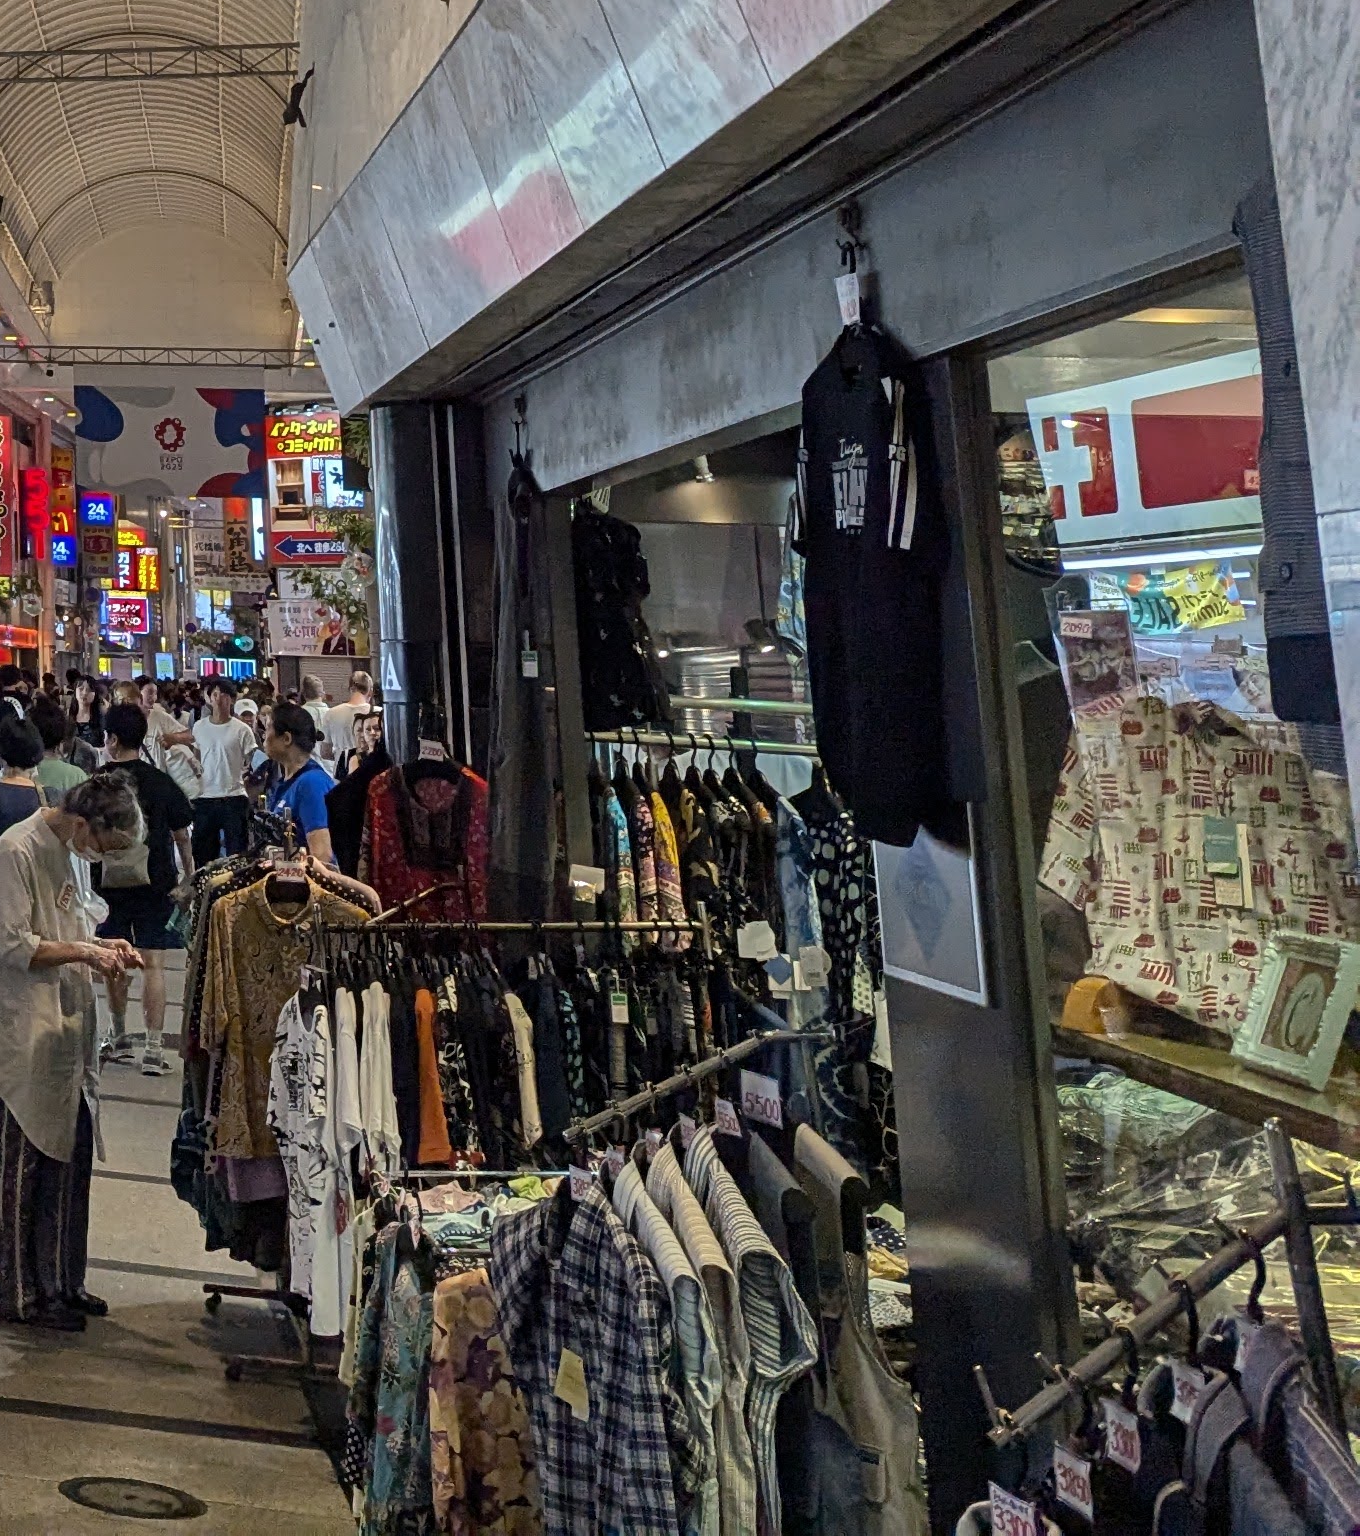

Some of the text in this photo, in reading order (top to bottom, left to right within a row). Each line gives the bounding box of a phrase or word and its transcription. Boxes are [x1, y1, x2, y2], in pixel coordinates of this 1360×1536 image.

[270, 419, 338, 437] インターネット
[25, 467, 50, 559] 551
[117, 551, 130, 588] ガスト
